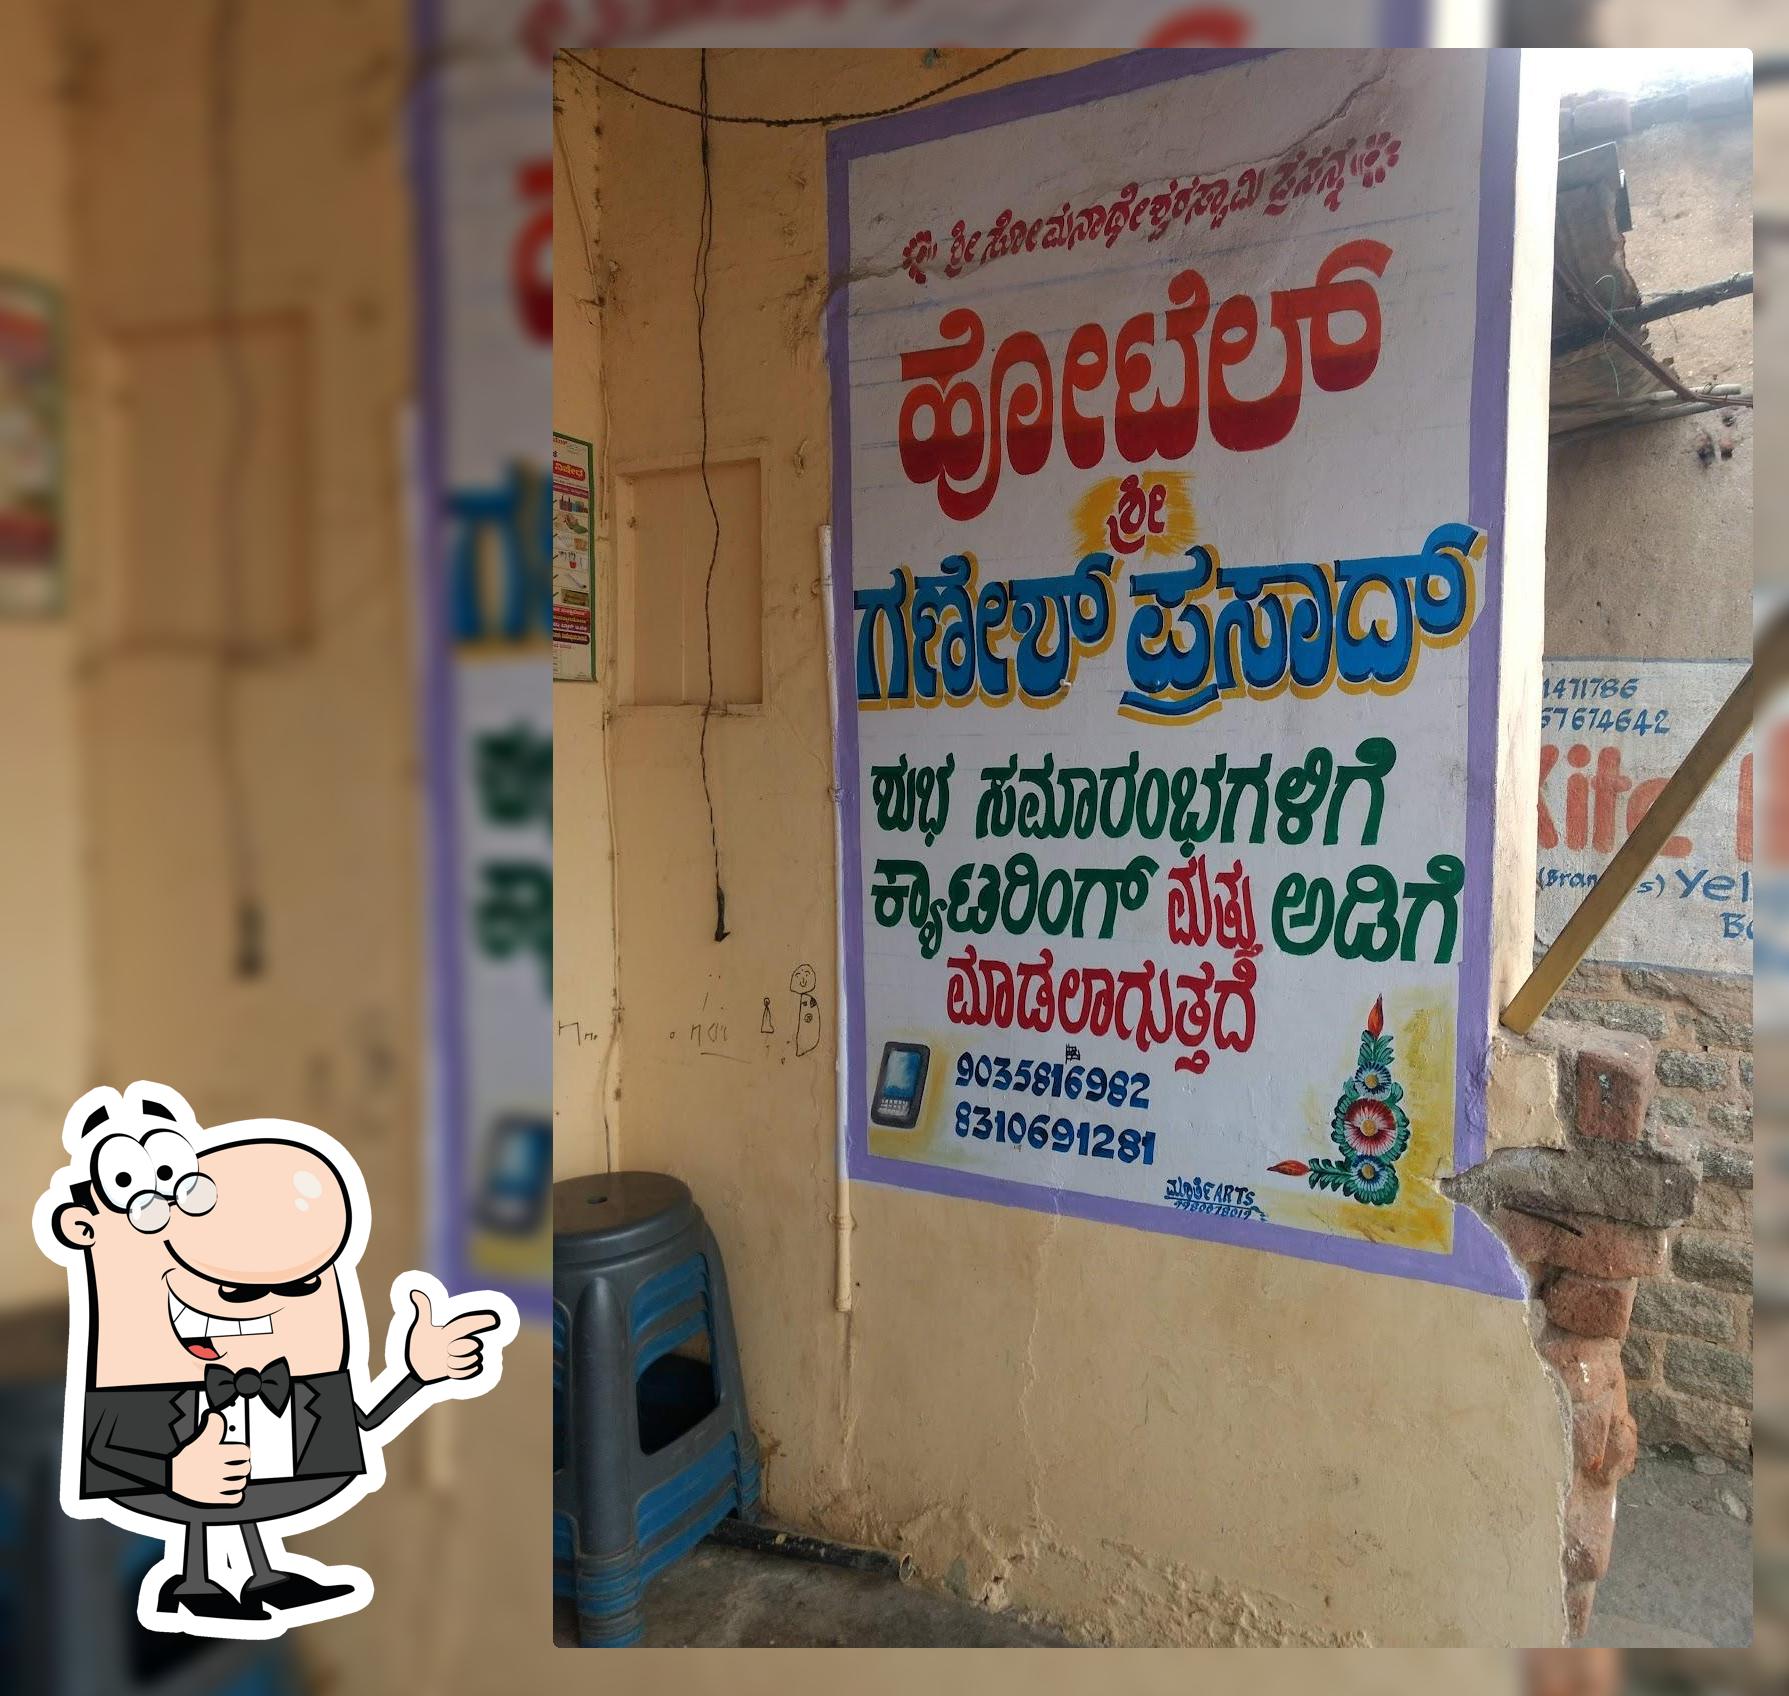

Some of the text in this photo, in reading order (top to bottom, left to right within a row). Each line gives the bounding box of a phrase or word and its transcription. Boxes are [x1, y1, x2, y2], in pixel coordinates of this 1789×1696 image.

[944, 219, 982, 278] ಶ್ರೀ
[898, 239, 1394, 522] ಹೋಟೆಲ್
[1107, 474, 1167, 555] ಶ್ರೀ
[853, 522, 1487, 726] ಗಣೇಶ್ ಪ್ರಸಾದ್
[871, 736, 1397, 858] ಶುಭ ಸಮಾರಂಭಗಳಿಗೆ
[870, 852, 1466, 964] ಕ್ಯಾಟರಿಂಗ್ ಮತ್ತು ಅಡಿಗೆ
[946, 944, 1258, 1075] ಮಾಡಲಾಗುತ್ತದೆ
[955, 1051, 1150, 1110] 9035816982
[955, 1101, 1157, 1165] 8310691281
